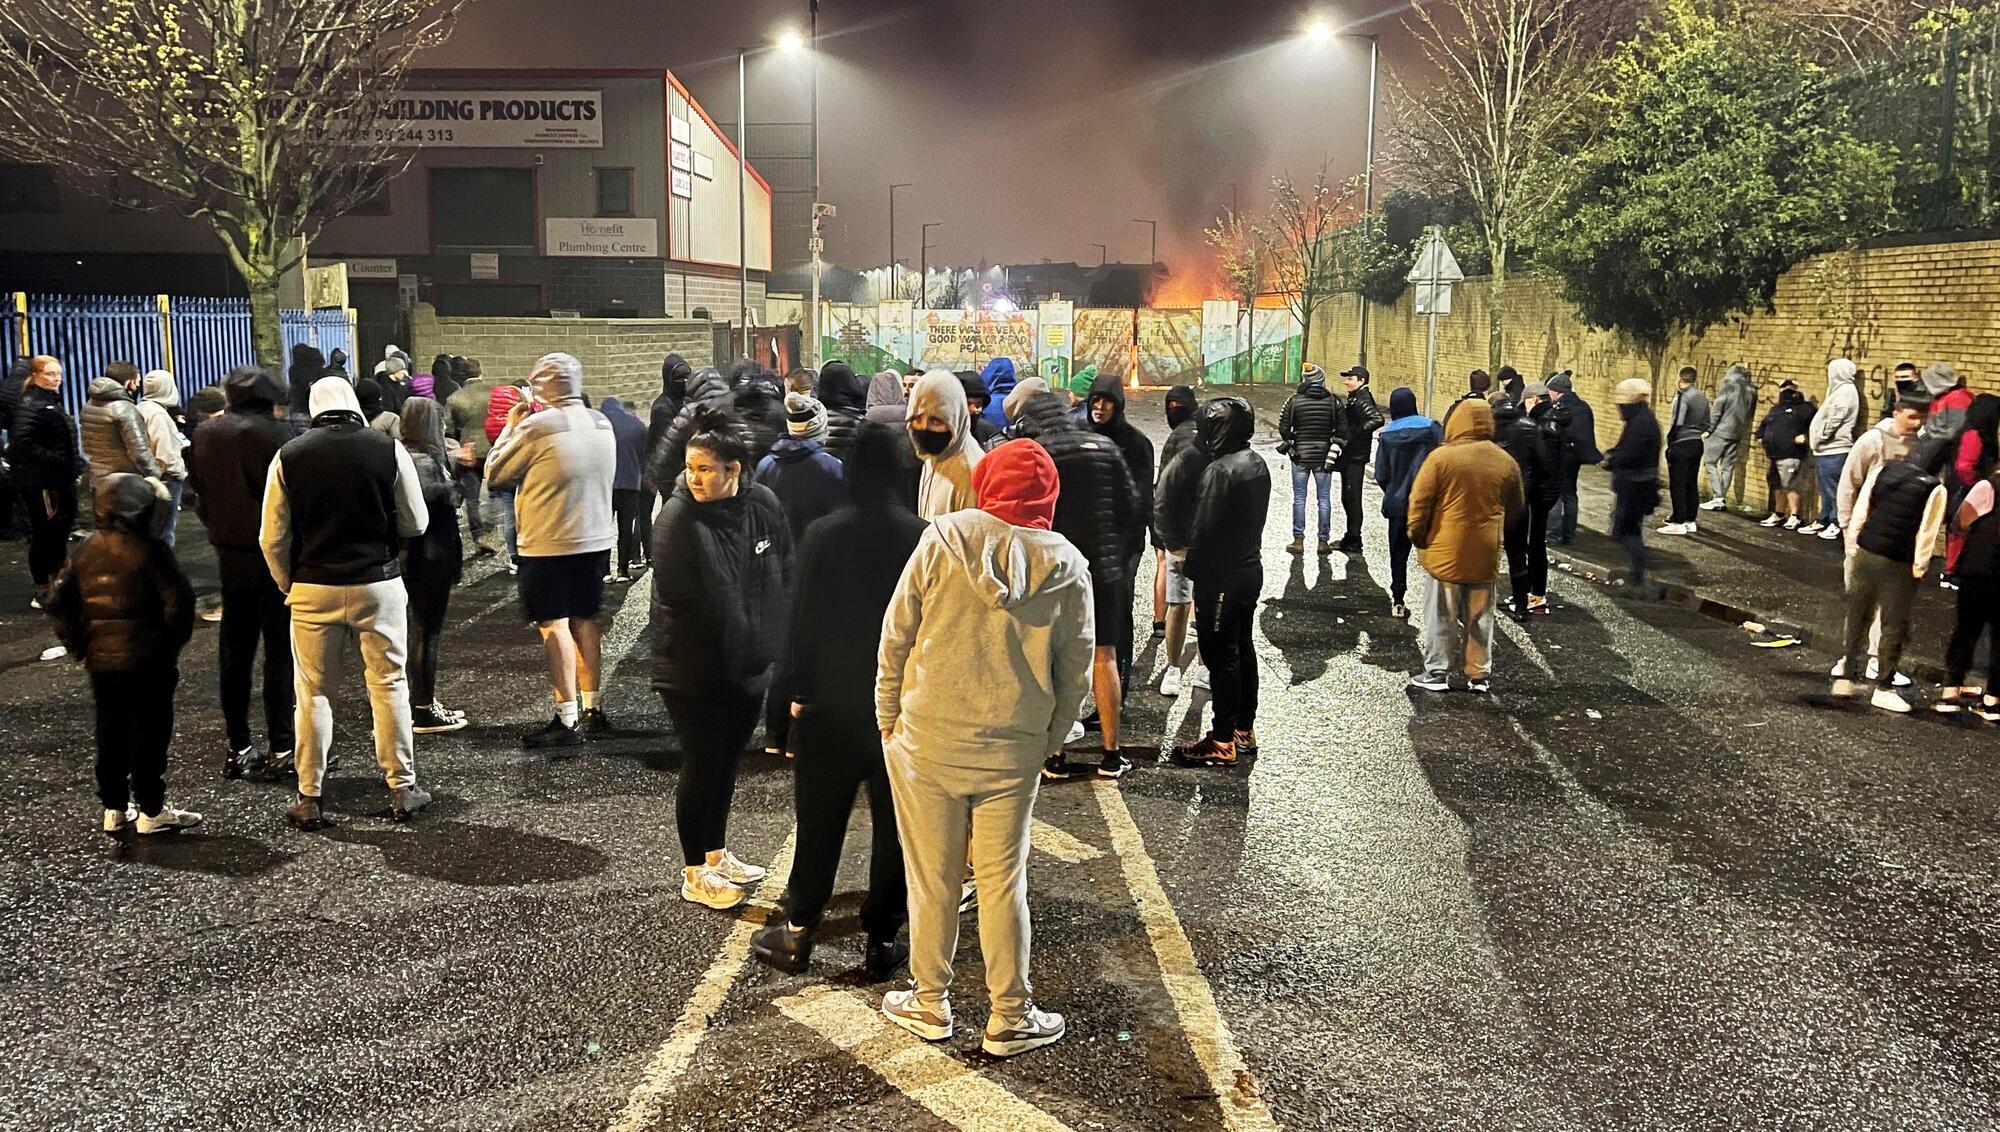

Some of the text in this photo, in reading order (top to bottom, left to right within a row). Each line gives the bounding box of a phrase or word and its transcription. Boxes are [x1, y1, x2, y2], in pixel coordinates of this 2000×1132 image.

[371, 100, 474, 120] UILDING
[479, 100, 597, 121] PRODUCTS
[427, 129, 453, 141] 313
[559, 241, 647, 254] Plumbing Centre
[352, 263, 393, 274] Counter
[928, 325, 957, 335] THERE
[958, 325, 981, 335] WAS
[928, 334, 957, 344] GOOD
[958, 334, 982, 344] WAR
